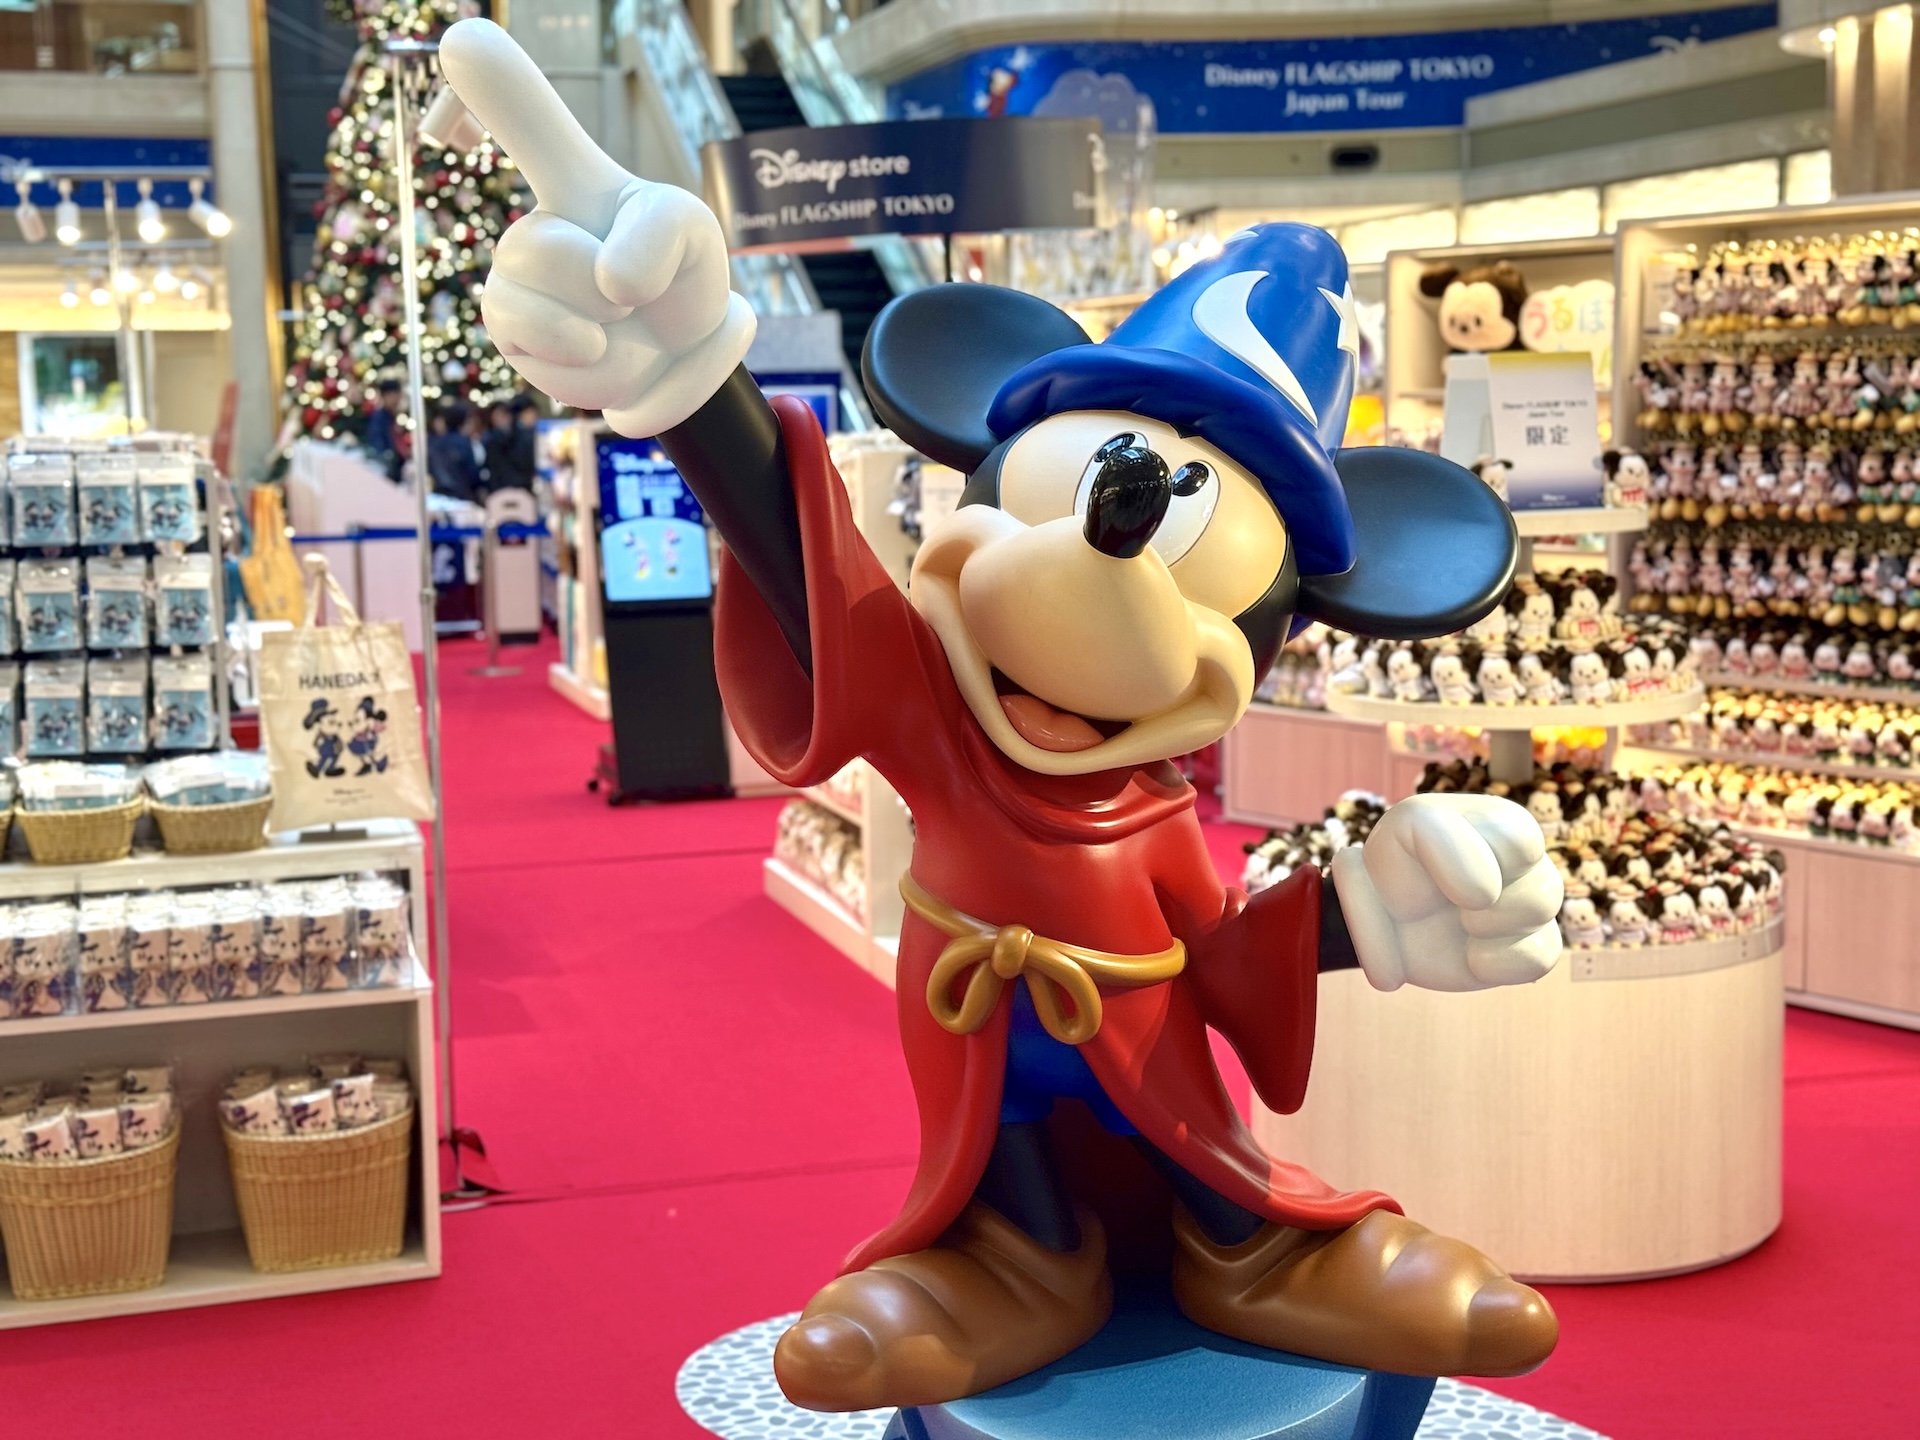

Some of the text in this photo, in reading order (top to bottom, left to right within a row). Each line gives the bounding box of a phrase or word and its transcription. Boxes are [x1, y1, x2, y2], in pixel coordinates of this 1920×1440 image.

[1204, 54, 1495, 89] Disney FLAGSHIP TOKYO
[1283, 87, 1406, 117] Japan Tour
[749, 148, 911, 193] Disney store
[734, 193, 955, 231] Disney FLAGSHIP TOKYO
[1526, 424, 1570, 446] 限定
[299, 671, 367, 689] HANEDA
